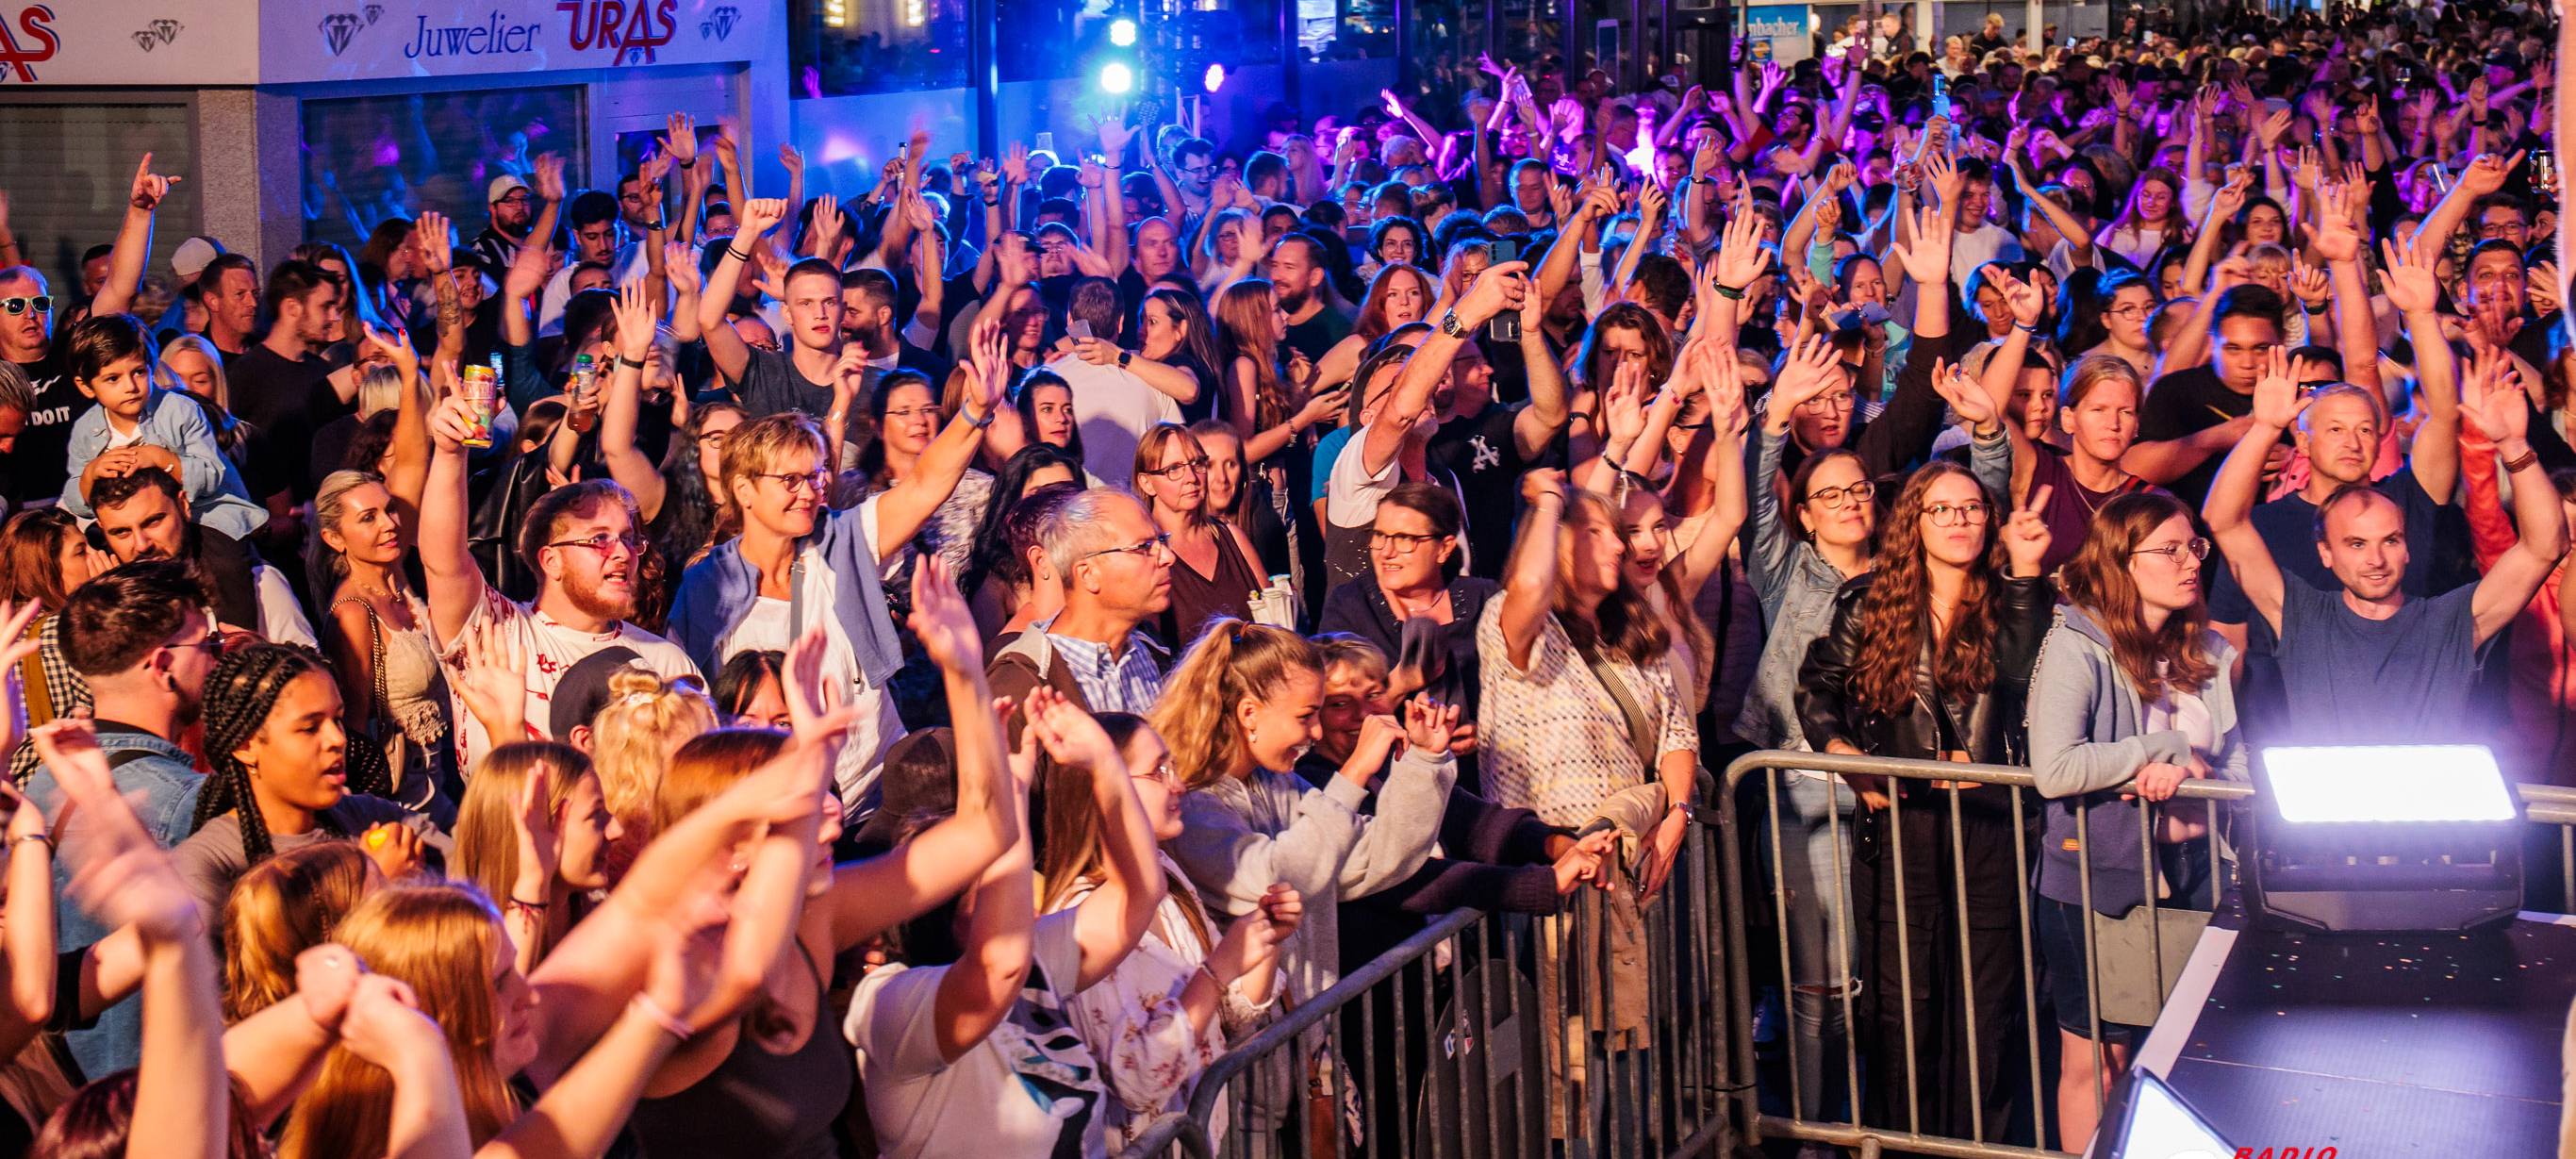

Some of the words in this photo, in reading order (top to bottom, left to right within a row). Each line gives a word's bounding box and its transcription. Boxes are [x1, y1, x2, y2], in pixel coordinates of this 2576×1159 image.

[405, 9, 540, 58] Juwelier
[555, 0, 677, 66] URAS
[31, 408, 55, 426] DO
[55, 406, 70, 423] IT
